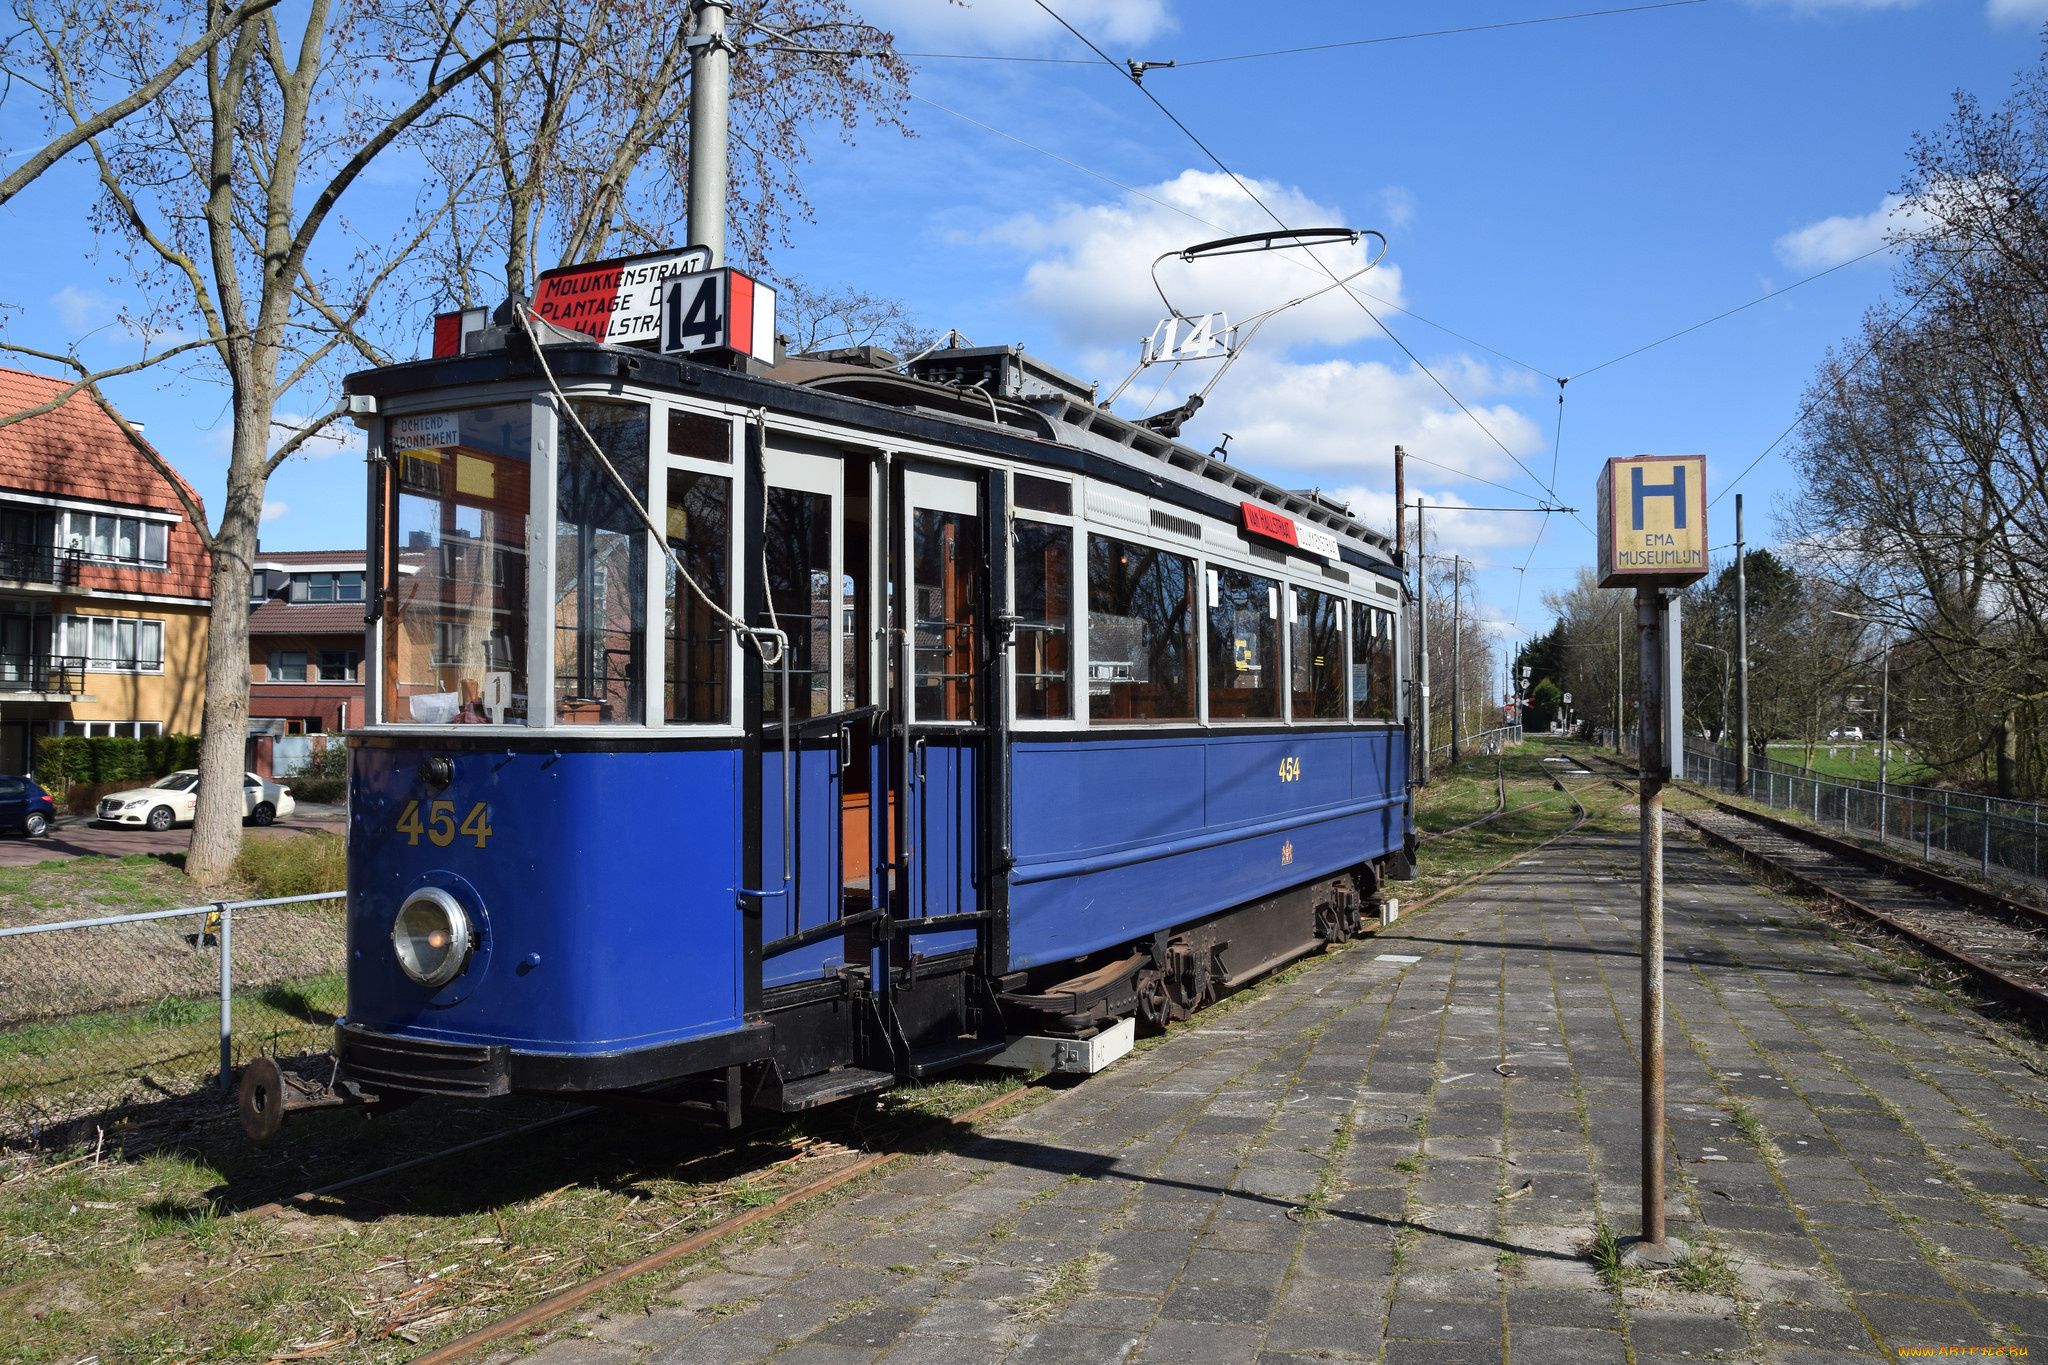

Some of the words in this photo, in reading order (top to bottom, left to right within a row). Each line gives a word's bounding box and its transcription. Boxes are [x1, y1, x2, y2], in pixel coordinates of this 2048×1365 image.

[540, 294, 633, 321] PLANTAGE
[665, 276, 722, 351] 14
[1157, 314, 1216, 360] 14
[393, 431, 457, 450] ABONNEMENT
[1631, 466, 1686, 530] H
[1645, 534, 1675, 546] EMA
[1279, 757, 1300, 783] 454
[396, 800, 493, 848] 454
